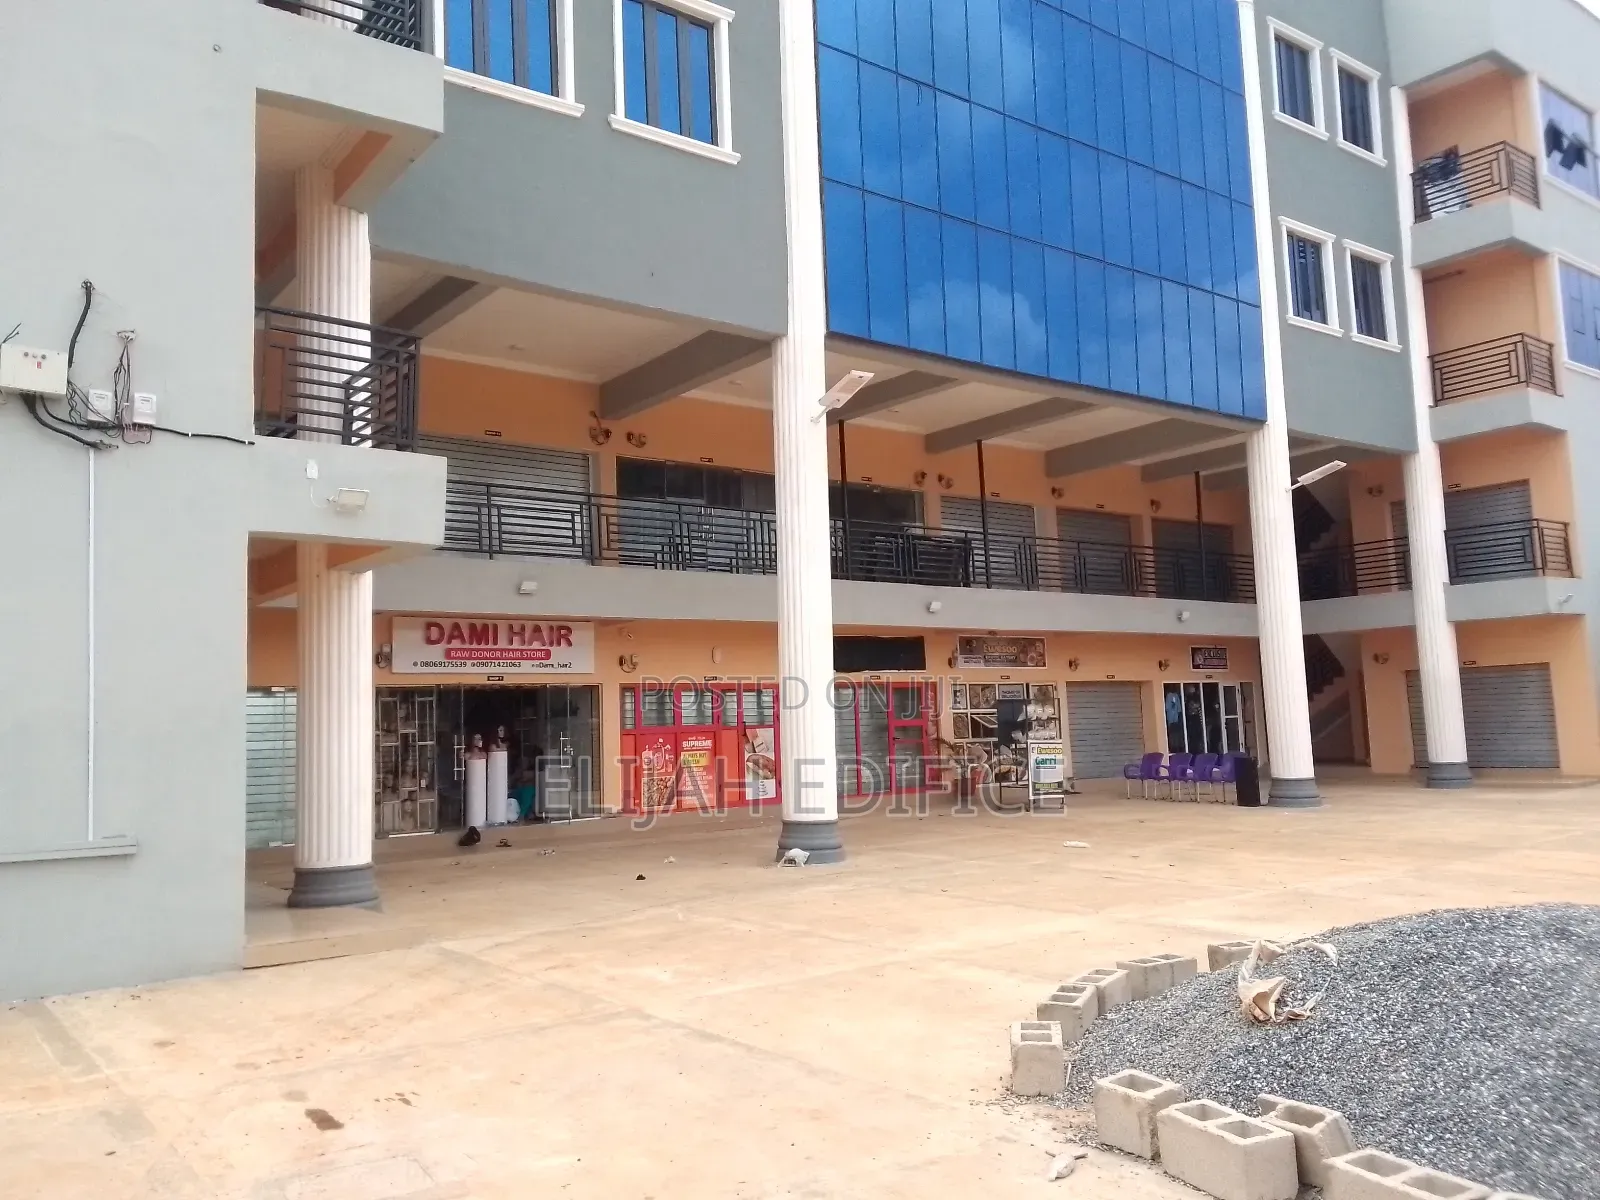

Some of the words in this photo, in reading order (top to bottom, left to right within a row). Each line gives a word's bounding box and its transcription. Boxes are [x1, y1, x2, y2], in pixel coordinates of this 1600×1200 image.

[425, 622, 499, 646] DAMI
[509, 623, 573, 647] HAIR
[450, 650, 469, 658] RAW
[471, 650, 501, 658] DONOR
[502, 650, 521, 658] HAIR
[522, 650, 546, 658] STORE
[1035, 755, 1056, 765] Garri
